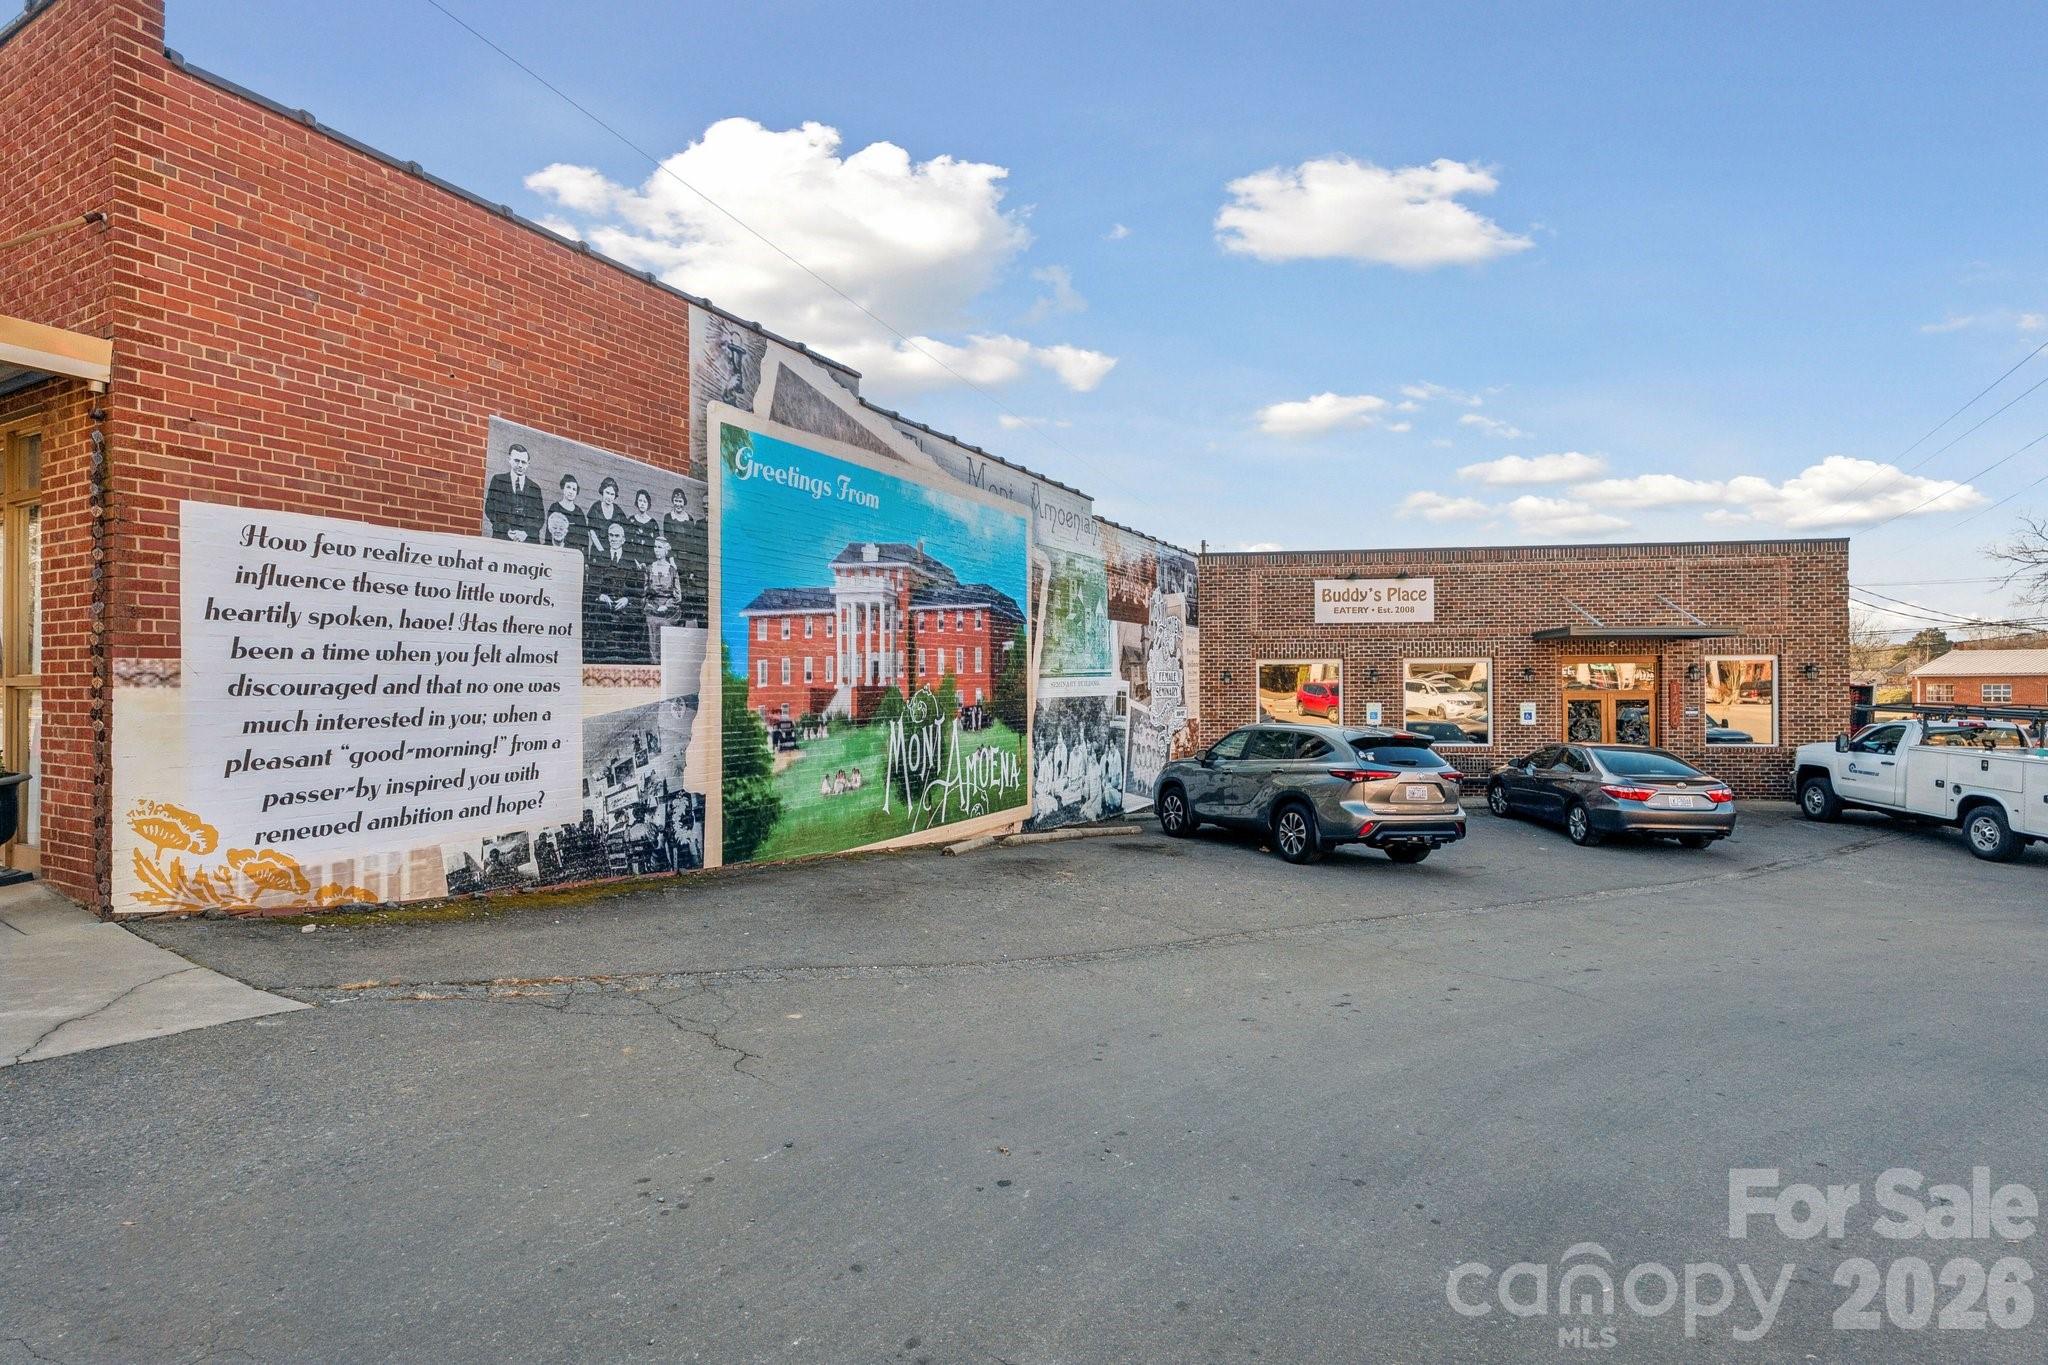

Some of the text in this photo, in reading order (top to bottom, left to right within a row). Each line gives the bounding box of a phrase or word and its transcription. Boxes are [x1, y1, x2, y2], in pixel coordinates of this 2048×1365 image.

[734, 446, 880, 509] Greetings From
[239, 524, 553, 581] How few realize what a magic
[234, 562, 555, 608] influence these two little words,
[1321, 587, 1428, 603] Buddy's Place
[204, 596, 573, 636] heartily spoken, have! Has there not
[1333, 605, 1415, 614] EATERY Est. 2008
[230, 635, 559, 667] been a time when you felt almost
[227, 673, 561, 701] discouraged and that no one was
[242, 704, 552, 735] much interested in you; when a
[223, 748, 333, 779] pleasant
[508, 733, 548, 757] from
[551, 738, 561, 750] a
[261, 761, 540, 813] passer-by inspired you with
[254, 790, 546, 846] renewed ambition and hope?
